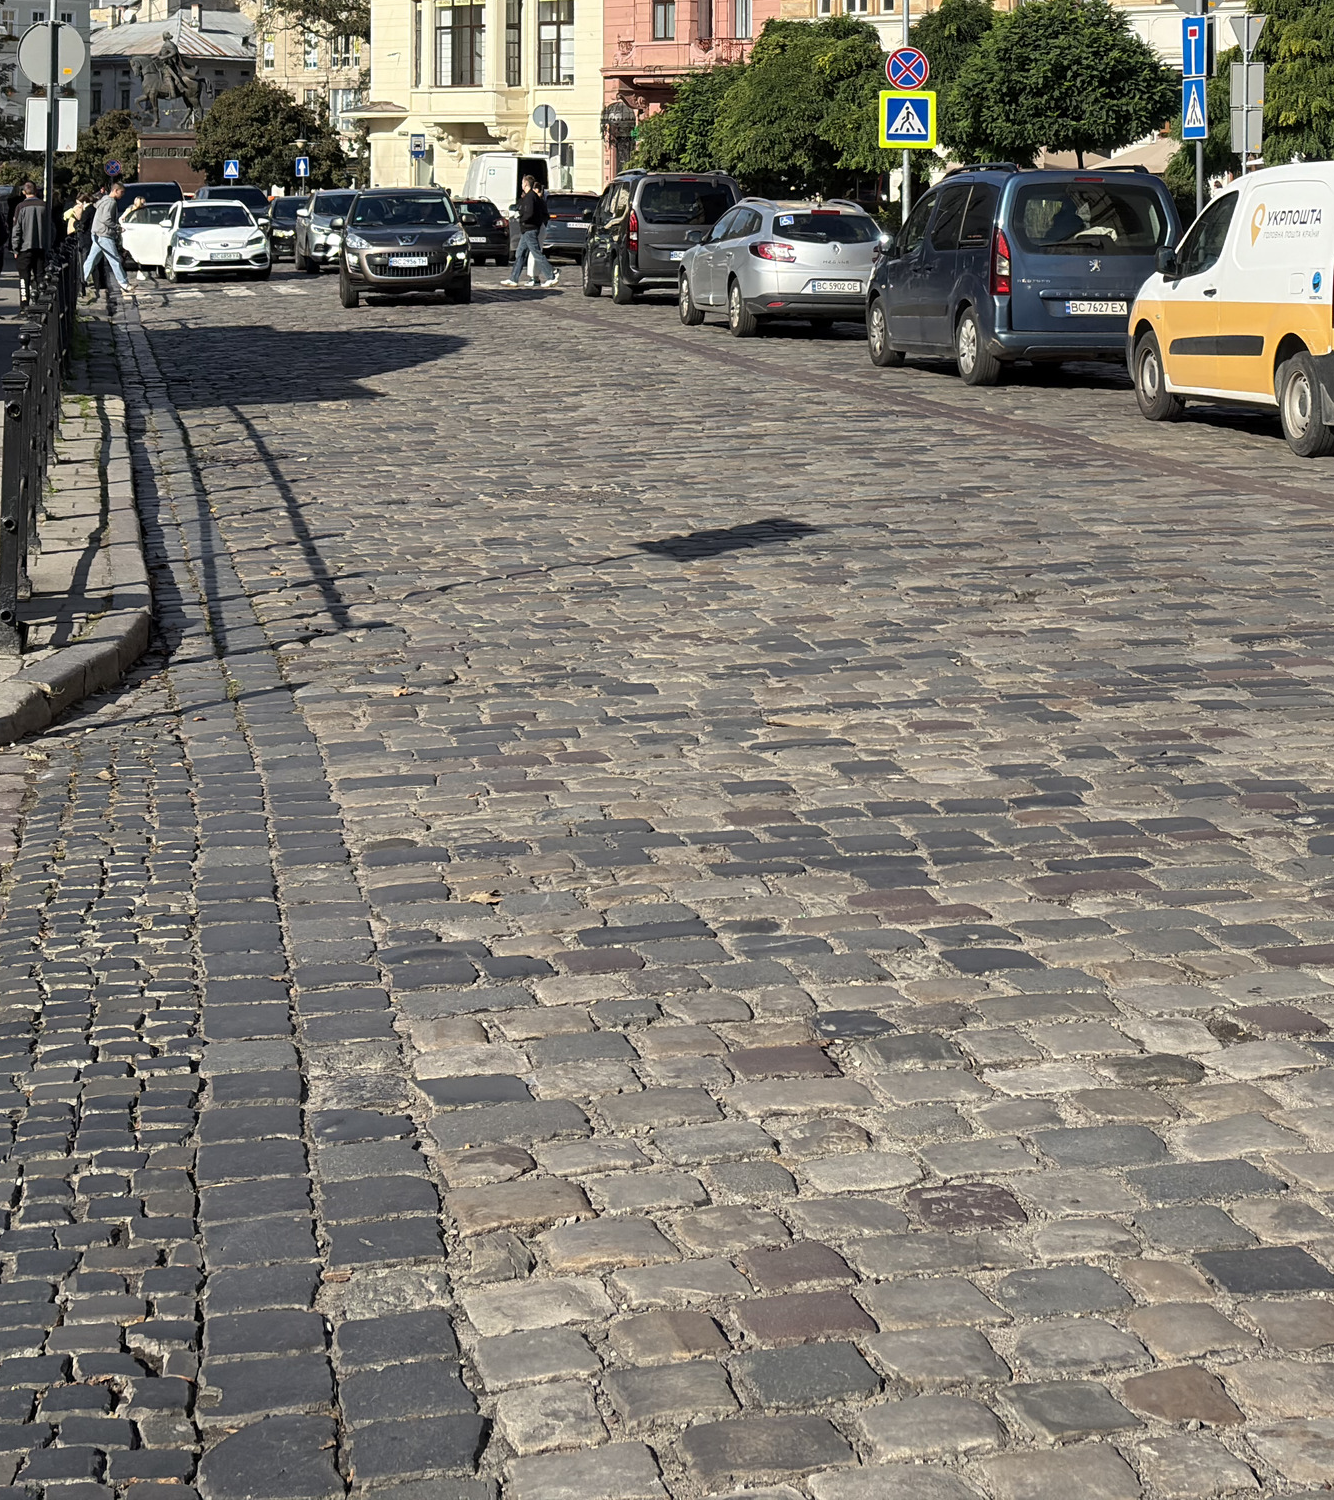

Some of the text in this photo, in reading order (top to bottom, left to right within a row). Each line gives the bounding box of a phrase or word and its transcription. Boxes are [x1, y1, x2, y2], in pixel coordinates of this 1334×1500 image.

[1267, 209, 1322, 226] УКРПОШТА
[816, 282, 859, 291] BC 5902 OE
[1071, 303, 1126, 313] BC 7627 EX
